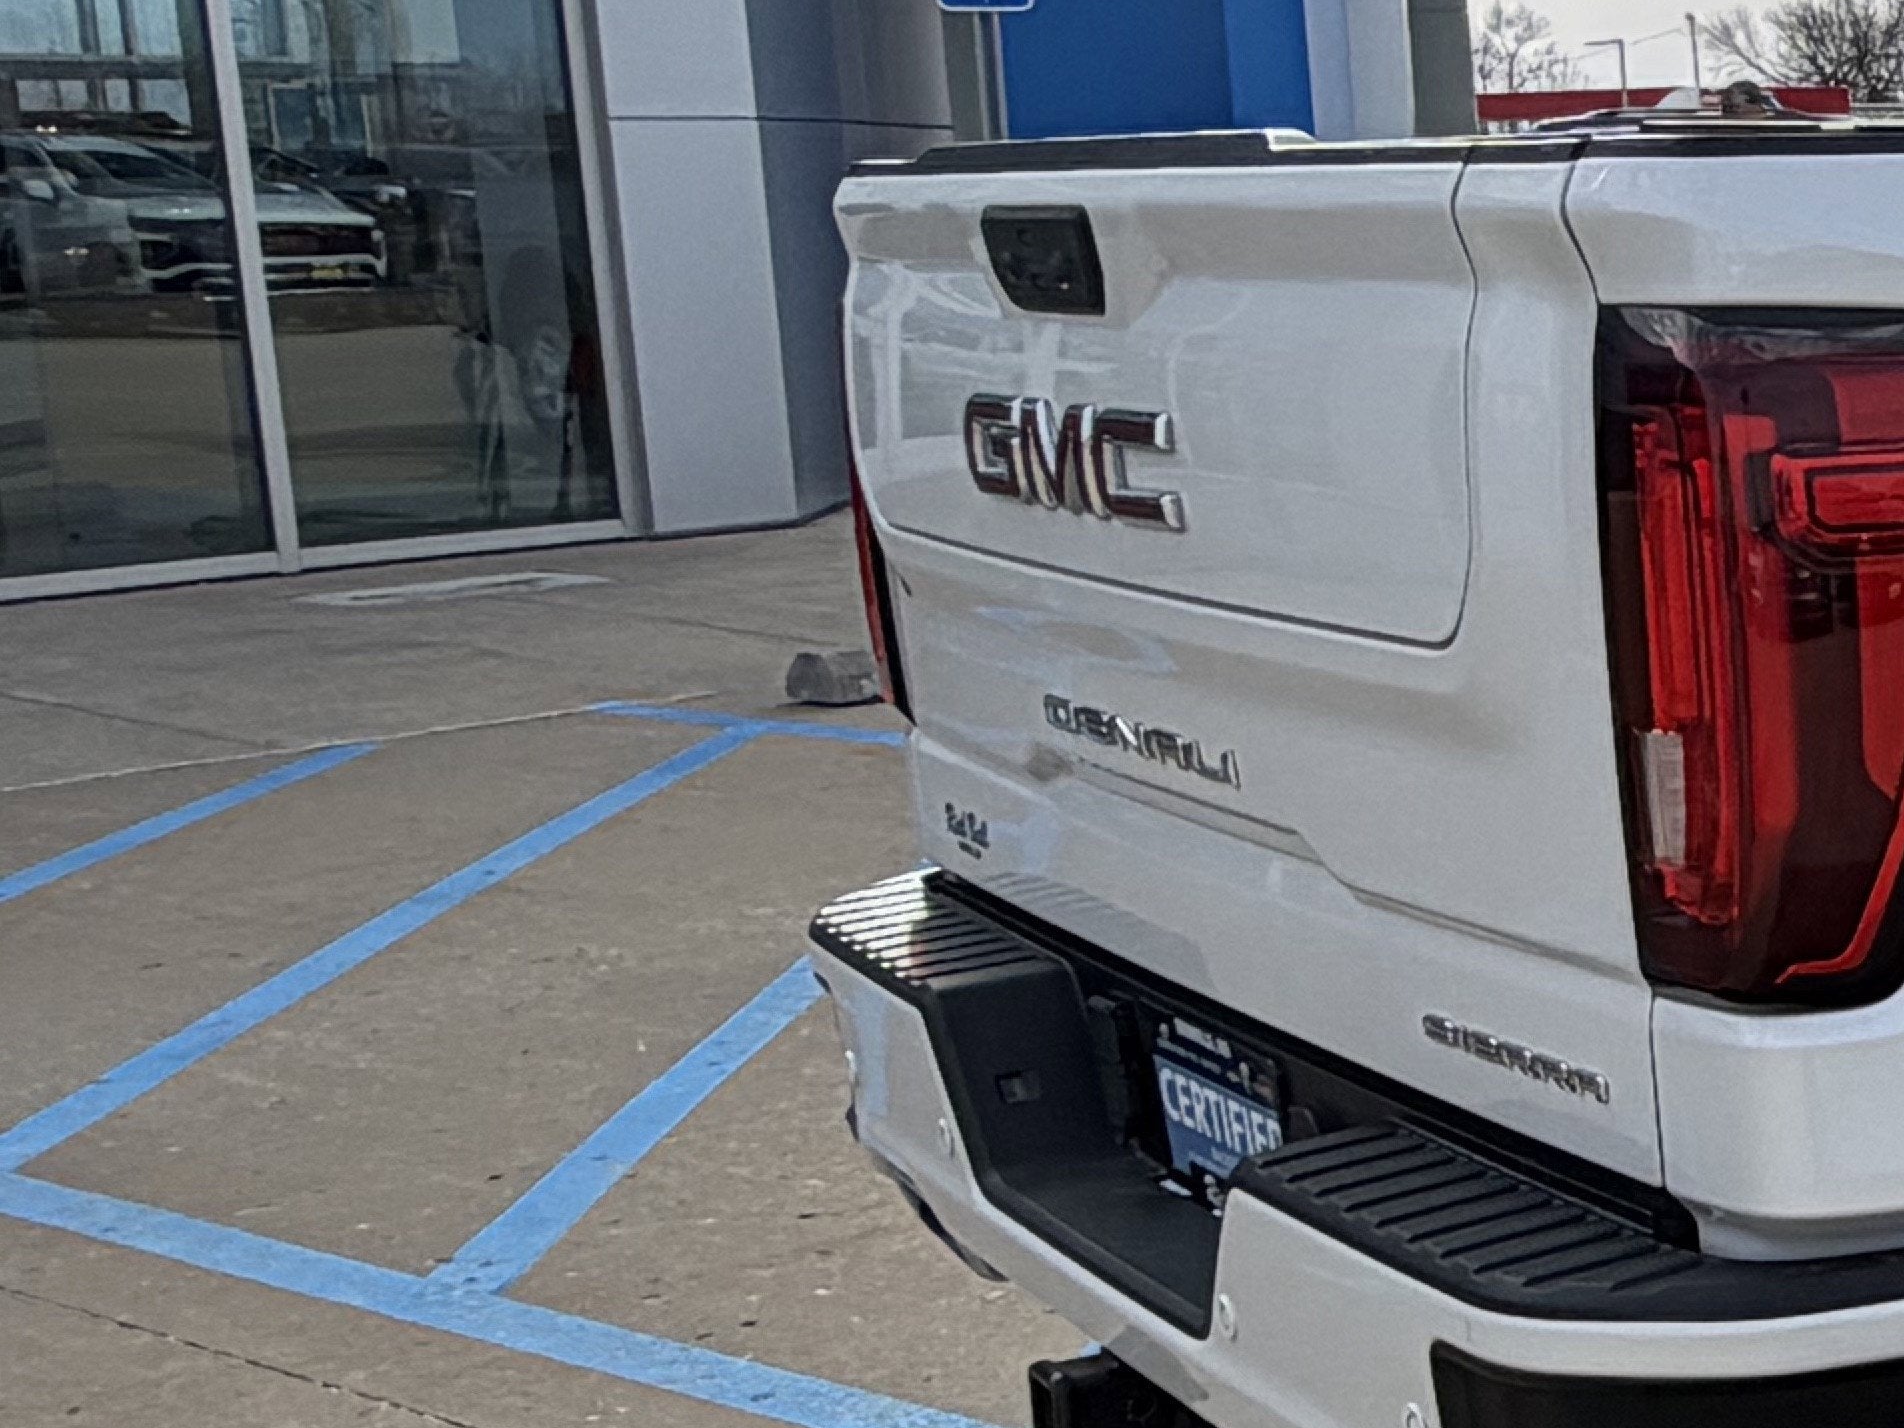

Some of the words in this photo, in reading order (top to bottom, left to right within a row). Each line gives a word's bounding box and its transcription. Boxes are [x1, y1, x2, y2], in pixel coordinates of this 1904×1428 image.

[964, 392, 1186, 532] GMC
[1043, 692, 1241, 791] DENALI
[1422, 1013, 1610, 1105] SIERRA
